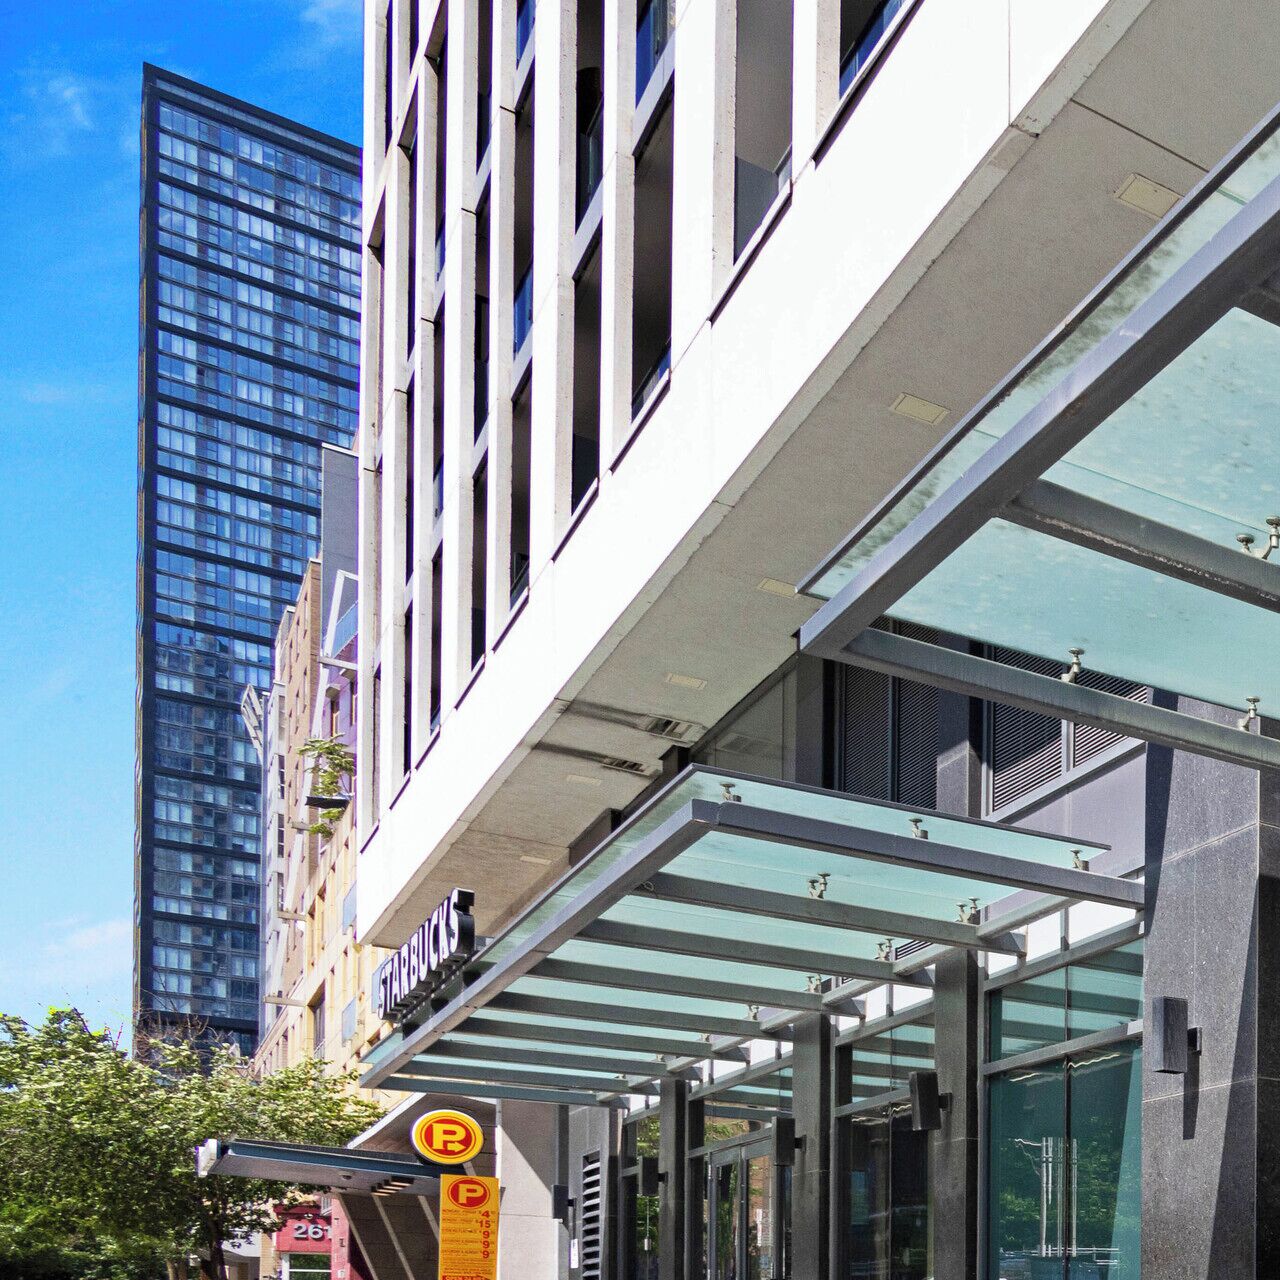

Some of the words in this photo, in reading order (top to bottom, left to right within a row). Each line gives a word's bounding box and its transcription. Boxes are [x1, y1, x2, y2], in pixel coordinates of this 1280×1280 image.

[378, 888, 474, 1020] STARBUCKS
[458, 1183, 484, 1204] P
[294, 1223, 332, 1240] 261
